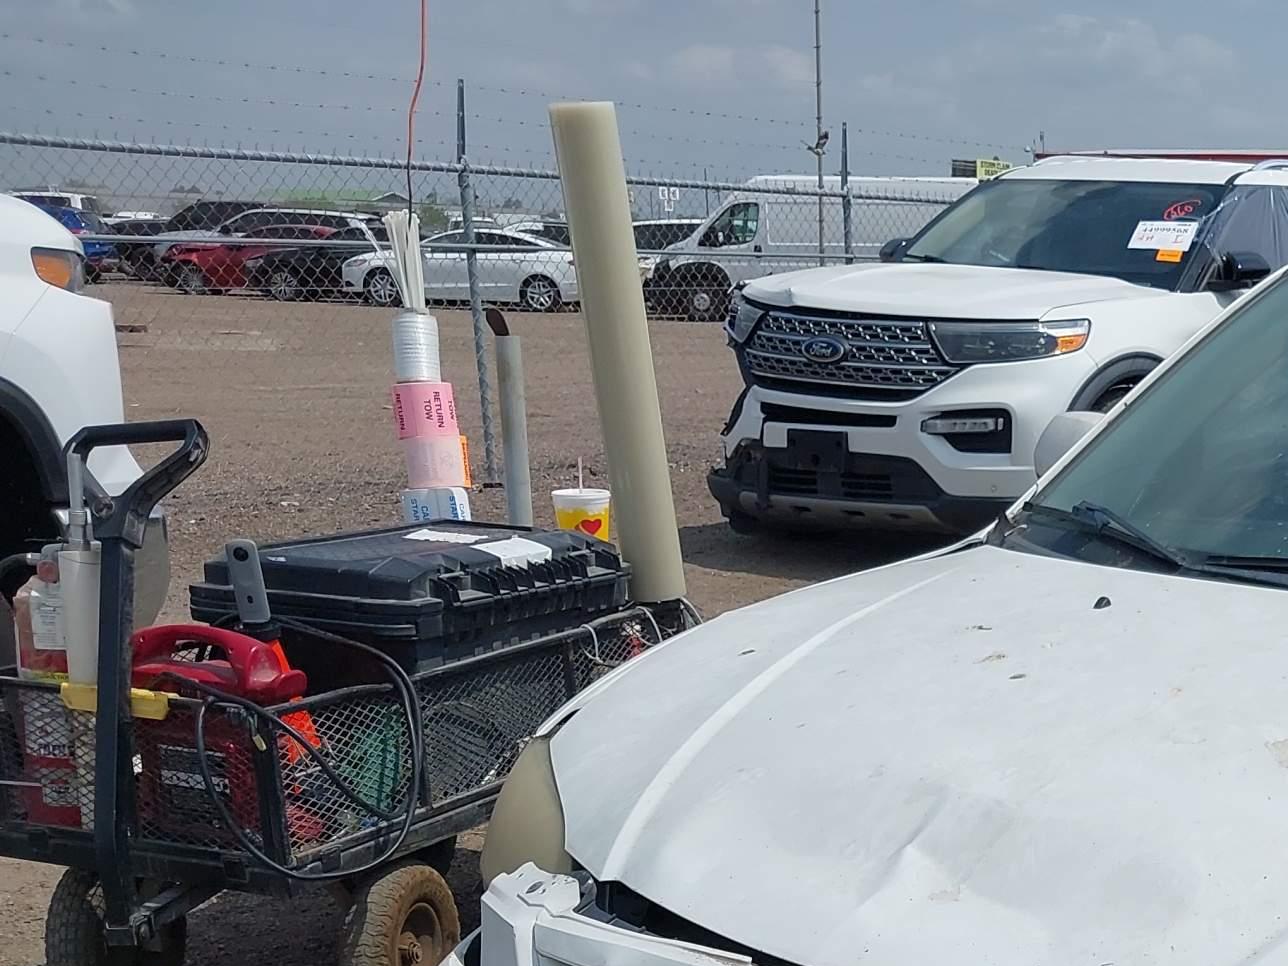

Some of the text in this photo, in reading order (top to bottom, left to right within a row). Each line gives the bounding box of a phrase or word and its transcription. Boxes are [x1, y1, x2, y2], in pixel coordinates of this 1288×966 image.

[809, 342, 833, 357] Ford
[423, 400, 434, 421] TOW
[432, 391, 446, 429] RETURN
